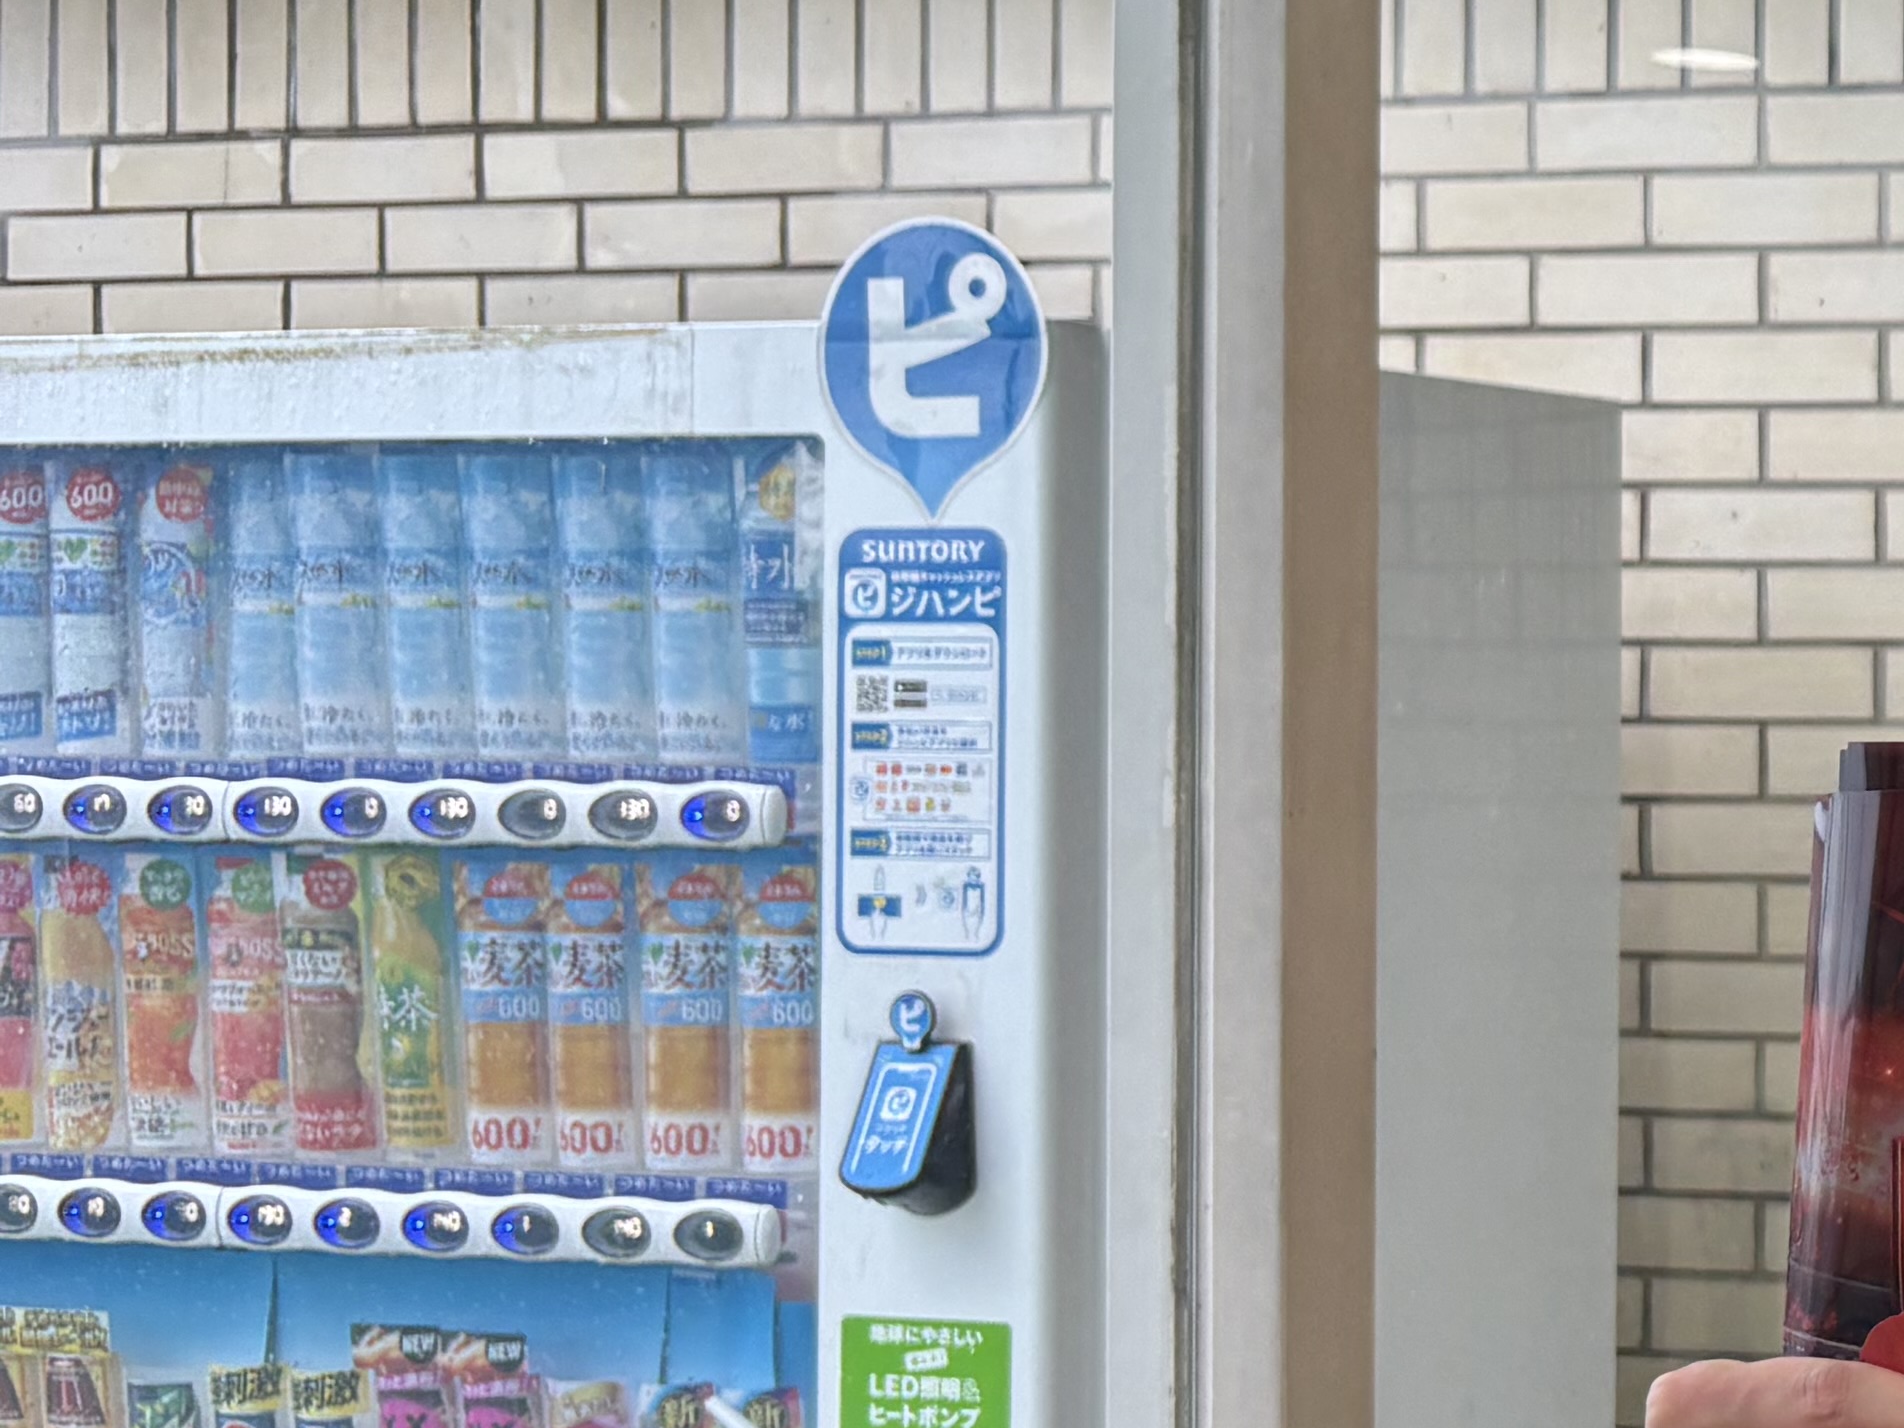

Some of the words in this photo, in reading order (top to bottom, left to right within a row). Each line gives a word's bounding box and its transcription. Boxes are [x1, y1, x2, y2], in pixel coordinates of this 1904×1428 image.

[866, 252, 1008, 438] ピ
[70, 481, 114, 507] 600
[862, 539, 985, 564] SUNTORY
[890, 586, 1002, 618] ジハンピ
[481, 938, 544, 990] 麦茶
[564, 939, 626, 991] 麦茶
[665, 939, 729, 991] 麦茶
[757, 942, 817, 993] 麦茶
[499, 996, 540, 1019] 600
[581, 996, 622, 1021] 600
[681, 997, 722, 1022] 600
[772, 999, 814, 1025] 600
[487, 1339, 522, 1362] NEW
